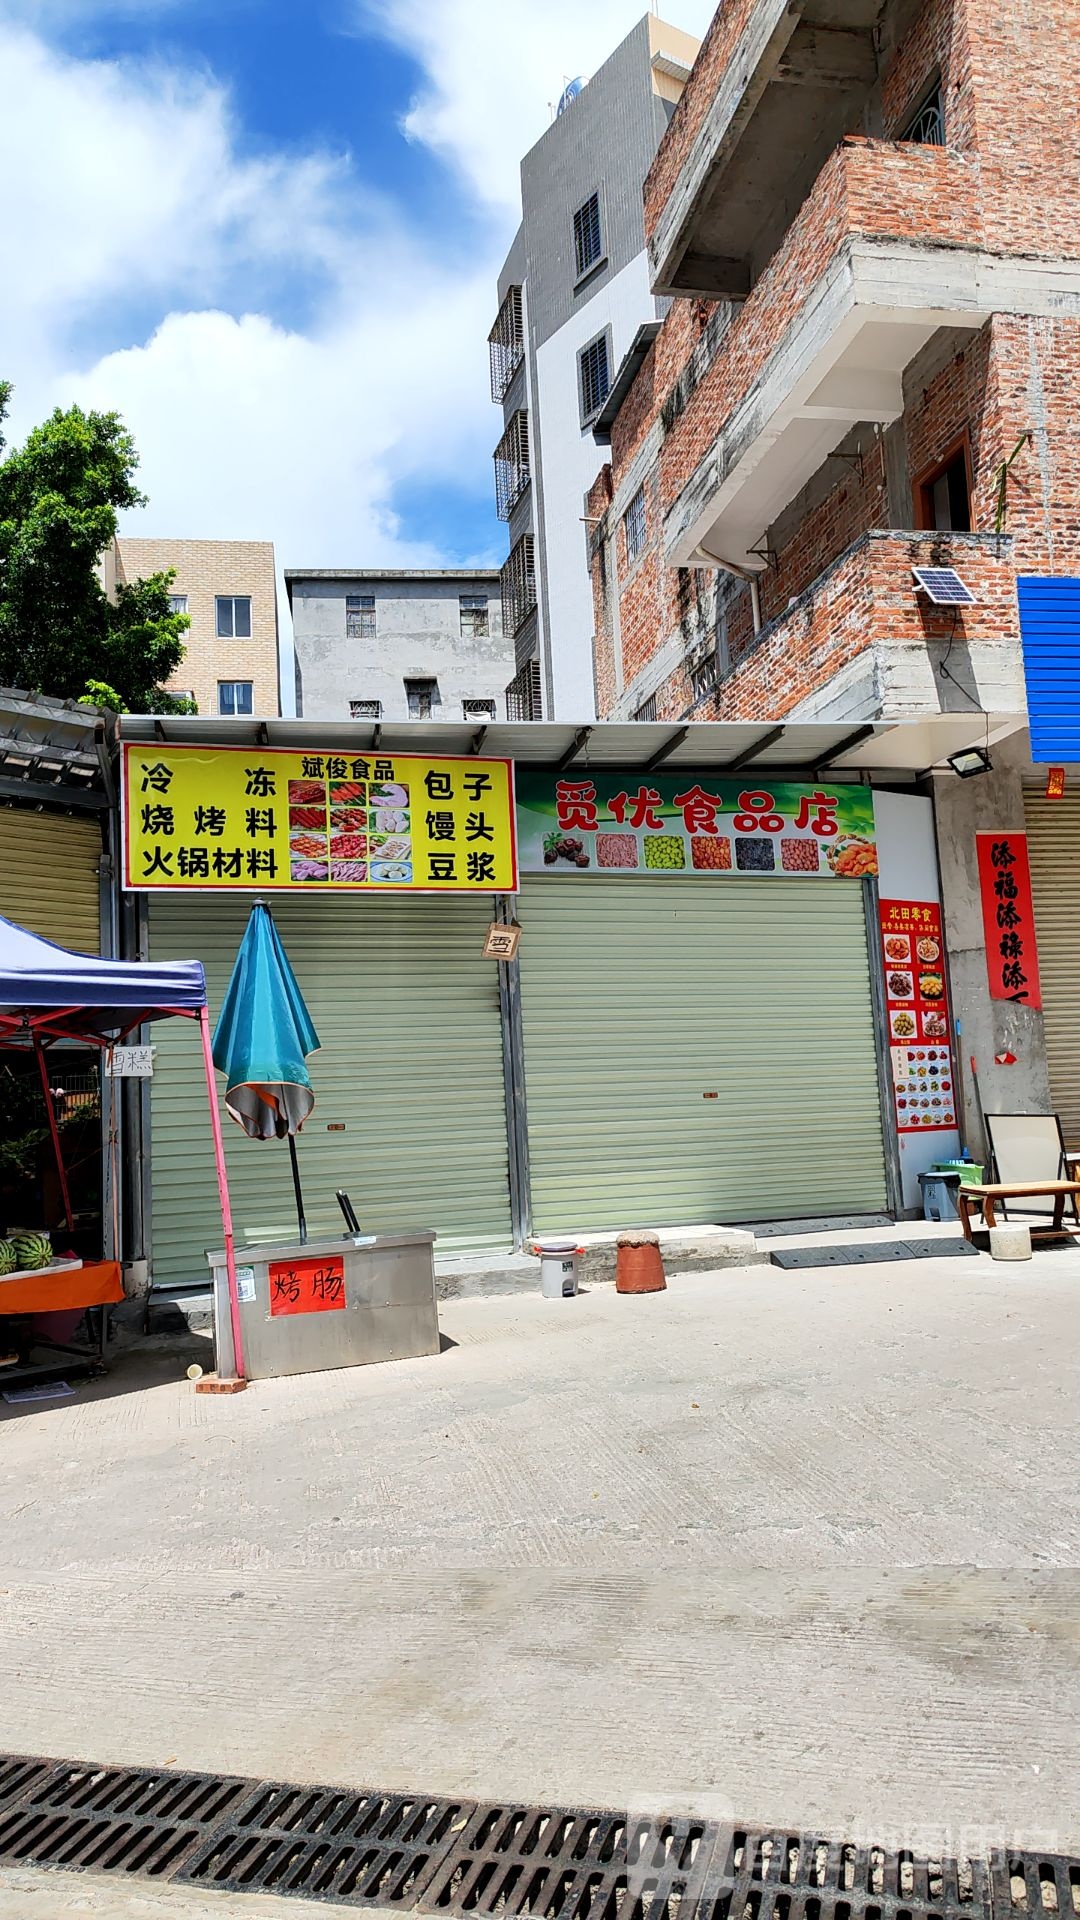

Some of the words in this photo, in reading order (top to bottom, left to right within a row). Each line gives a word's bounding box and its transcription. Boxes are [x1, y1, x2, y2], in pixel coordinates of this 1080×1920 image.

[141, 763, 276, 797] 冷冻
[301, 756, 395, 781] 斌俊食品
[424, 770, 492, 801] 包子
[141, 804, 277, 838] 烧烤料
[556, 780, 839, 836] 觅优食品店
[425, 811, 494, 841] 馒头
[142, 846, 278, 879] 火锅材料
[427, 852, 496, 881] 豆浆
[889, 906, 932, 922] 北田零食
[272, 1266, 344, 1303] 烤肠
